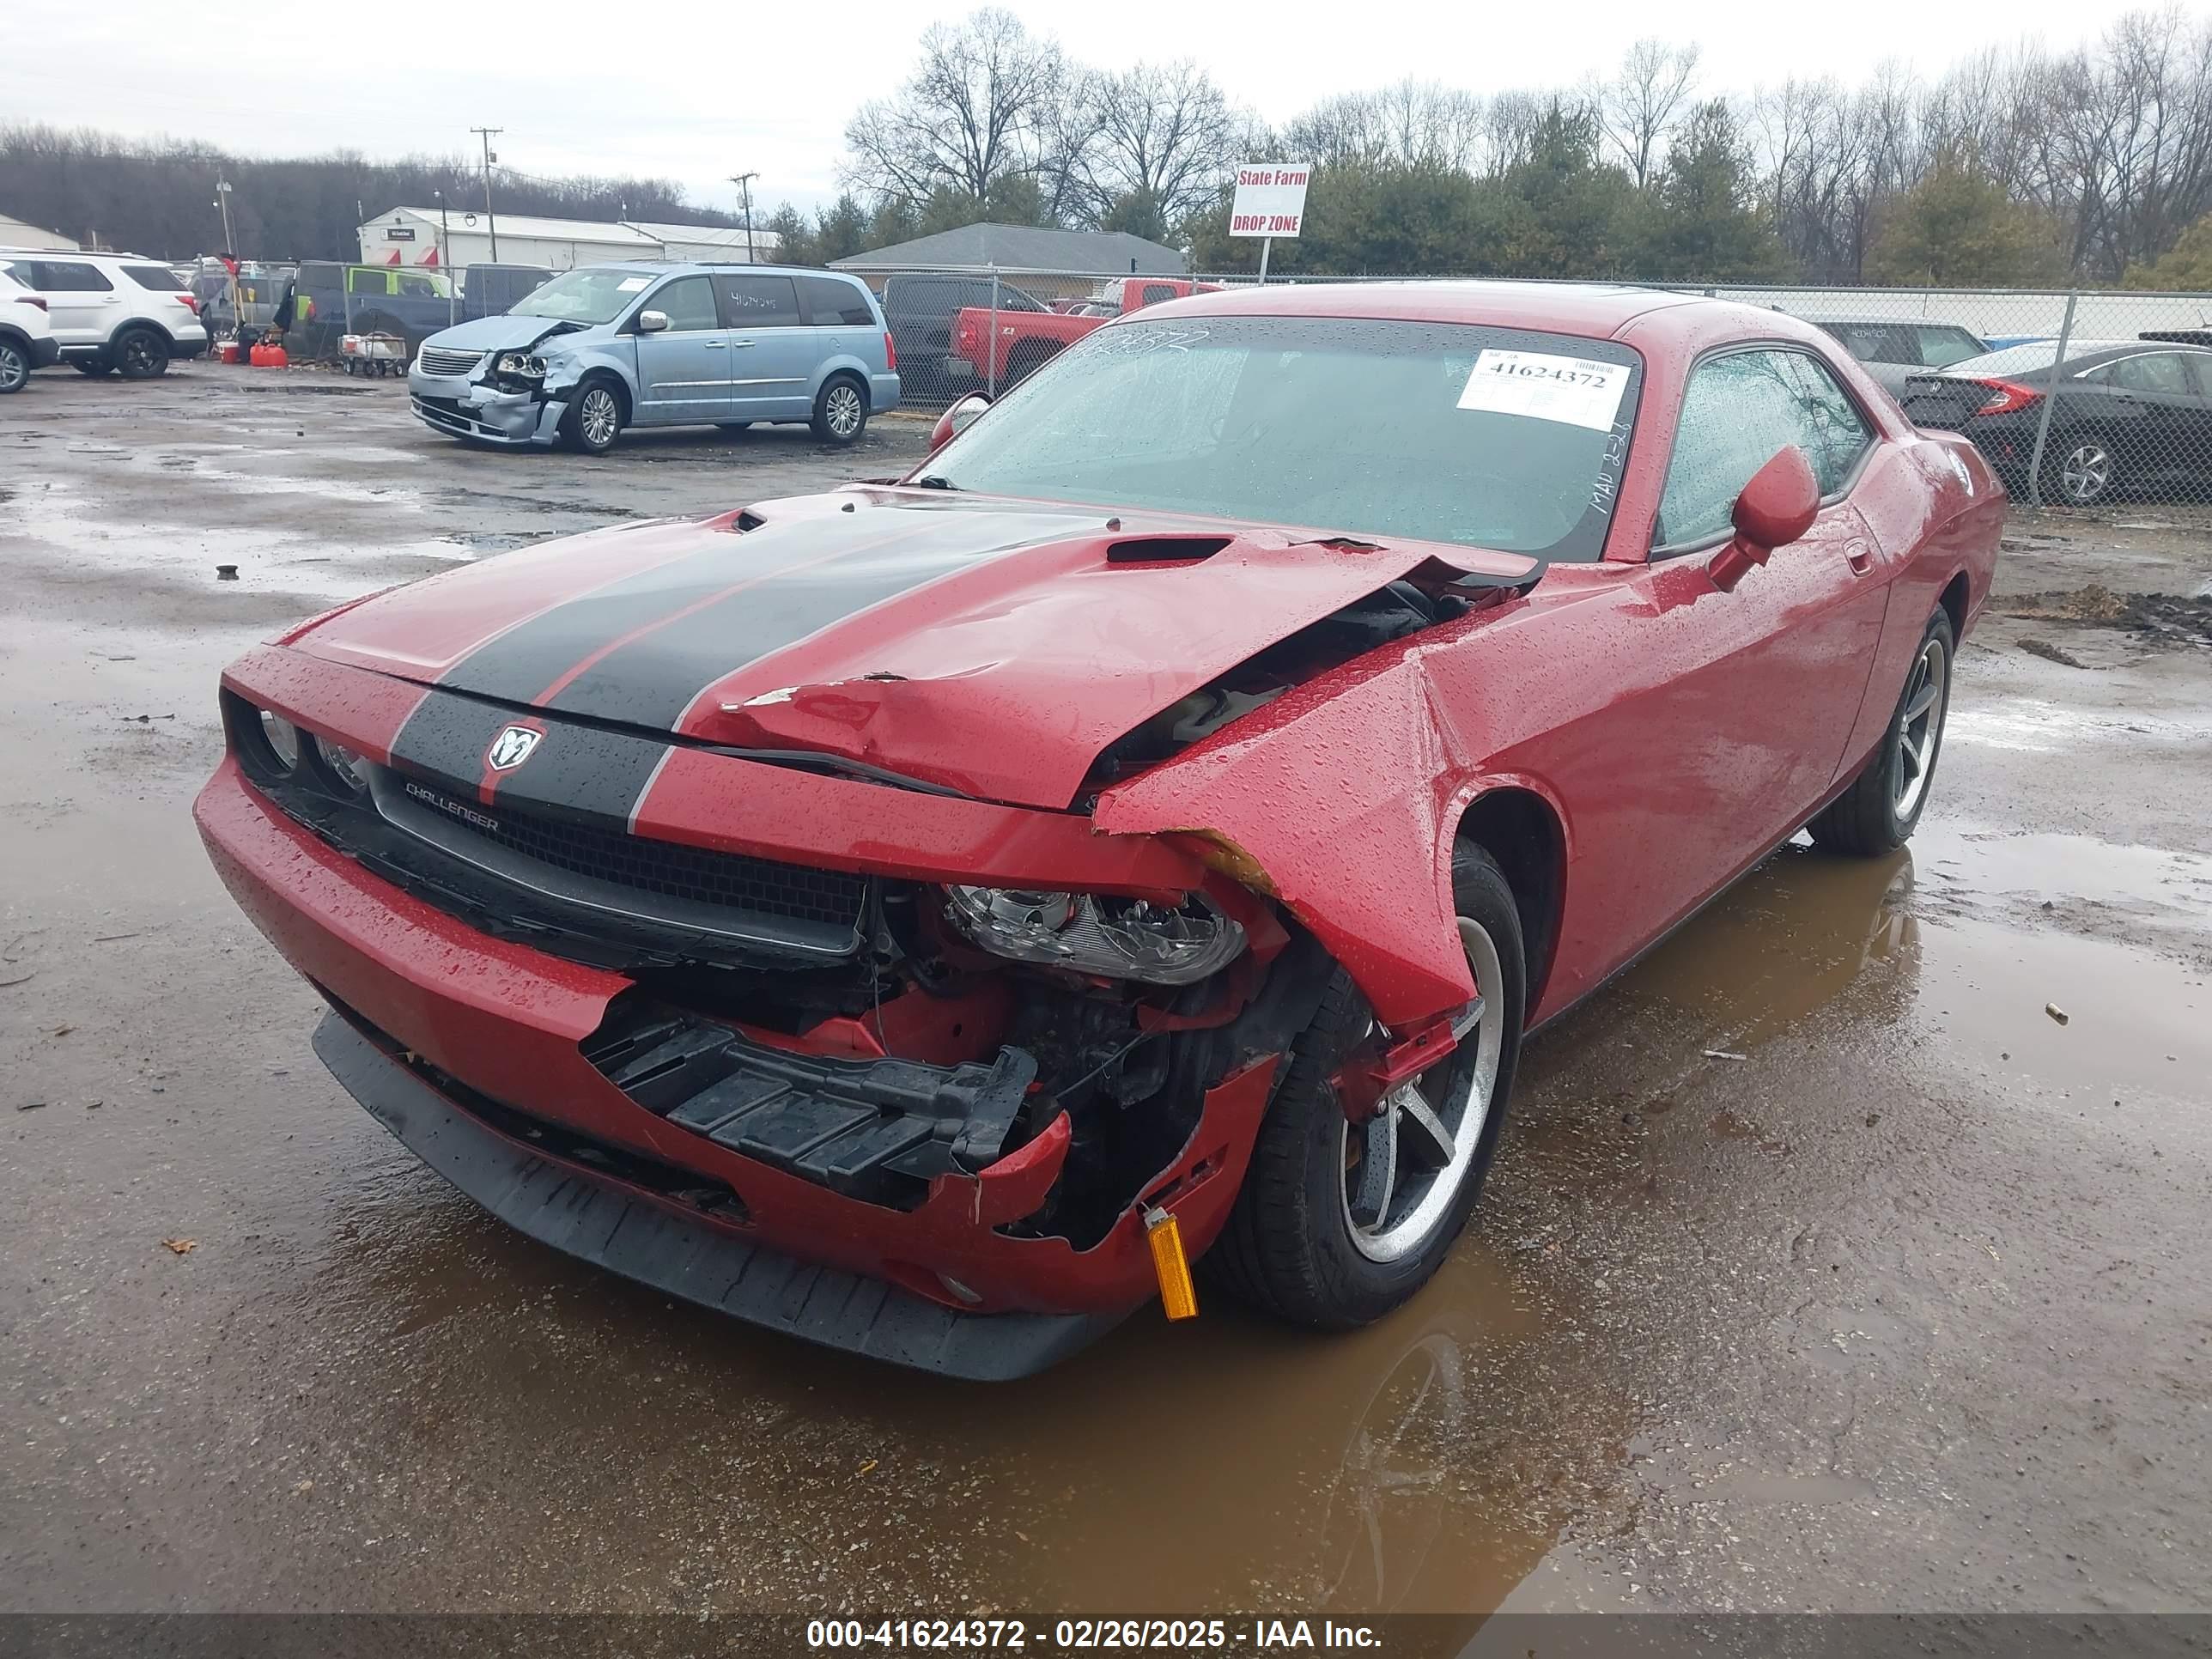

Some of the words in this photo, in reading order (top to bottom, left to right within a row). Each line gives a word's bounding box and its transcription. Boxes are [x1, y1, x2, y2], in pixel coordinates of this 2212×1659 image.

[1239, 169, 1272, 185] State
[1274, 169, 1307, 185] Farm
[1233, 215, 1267, 232] DROP
[1267, 215, 1298, 232] ZONE
[1490, 362, 1607, 389] 41624372
[405, 782, 498, 831] CHALLENGER
